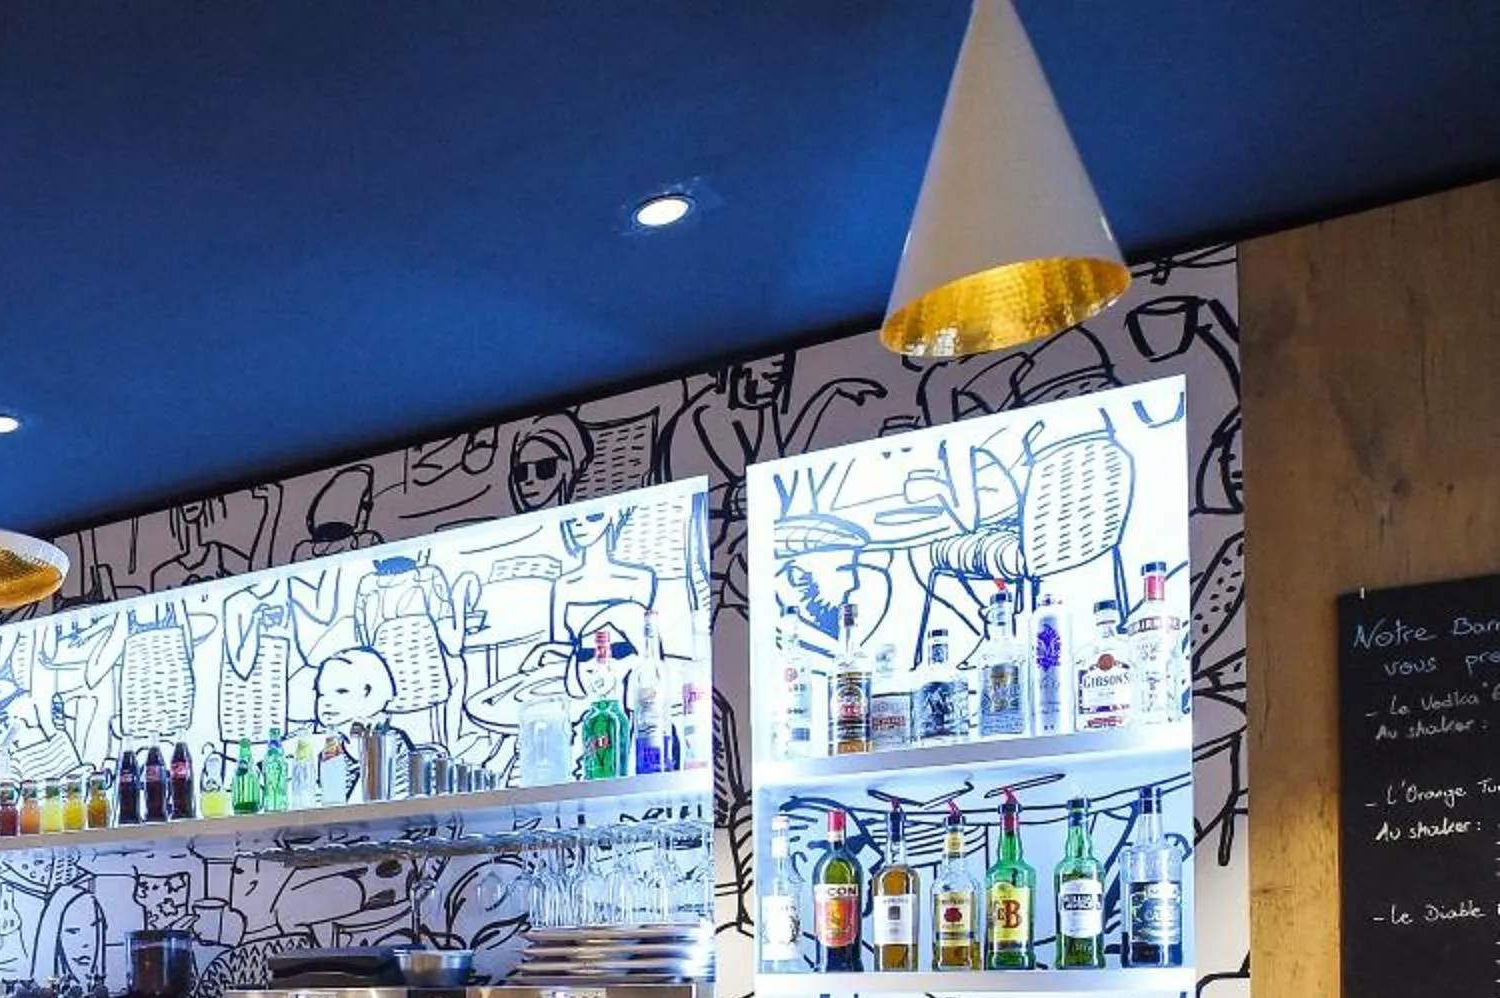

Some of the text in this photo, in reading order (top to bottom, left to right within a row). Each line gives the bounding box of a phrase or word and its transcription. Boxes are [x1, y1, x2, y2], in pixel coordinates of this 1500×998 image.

[1353, 618, 1438, 648] Notre
[1383, 657, 1437, 676] vous
[1387, 779, 1467, 808] L'Orange
[1424, 900, 1486, 922] Diable
